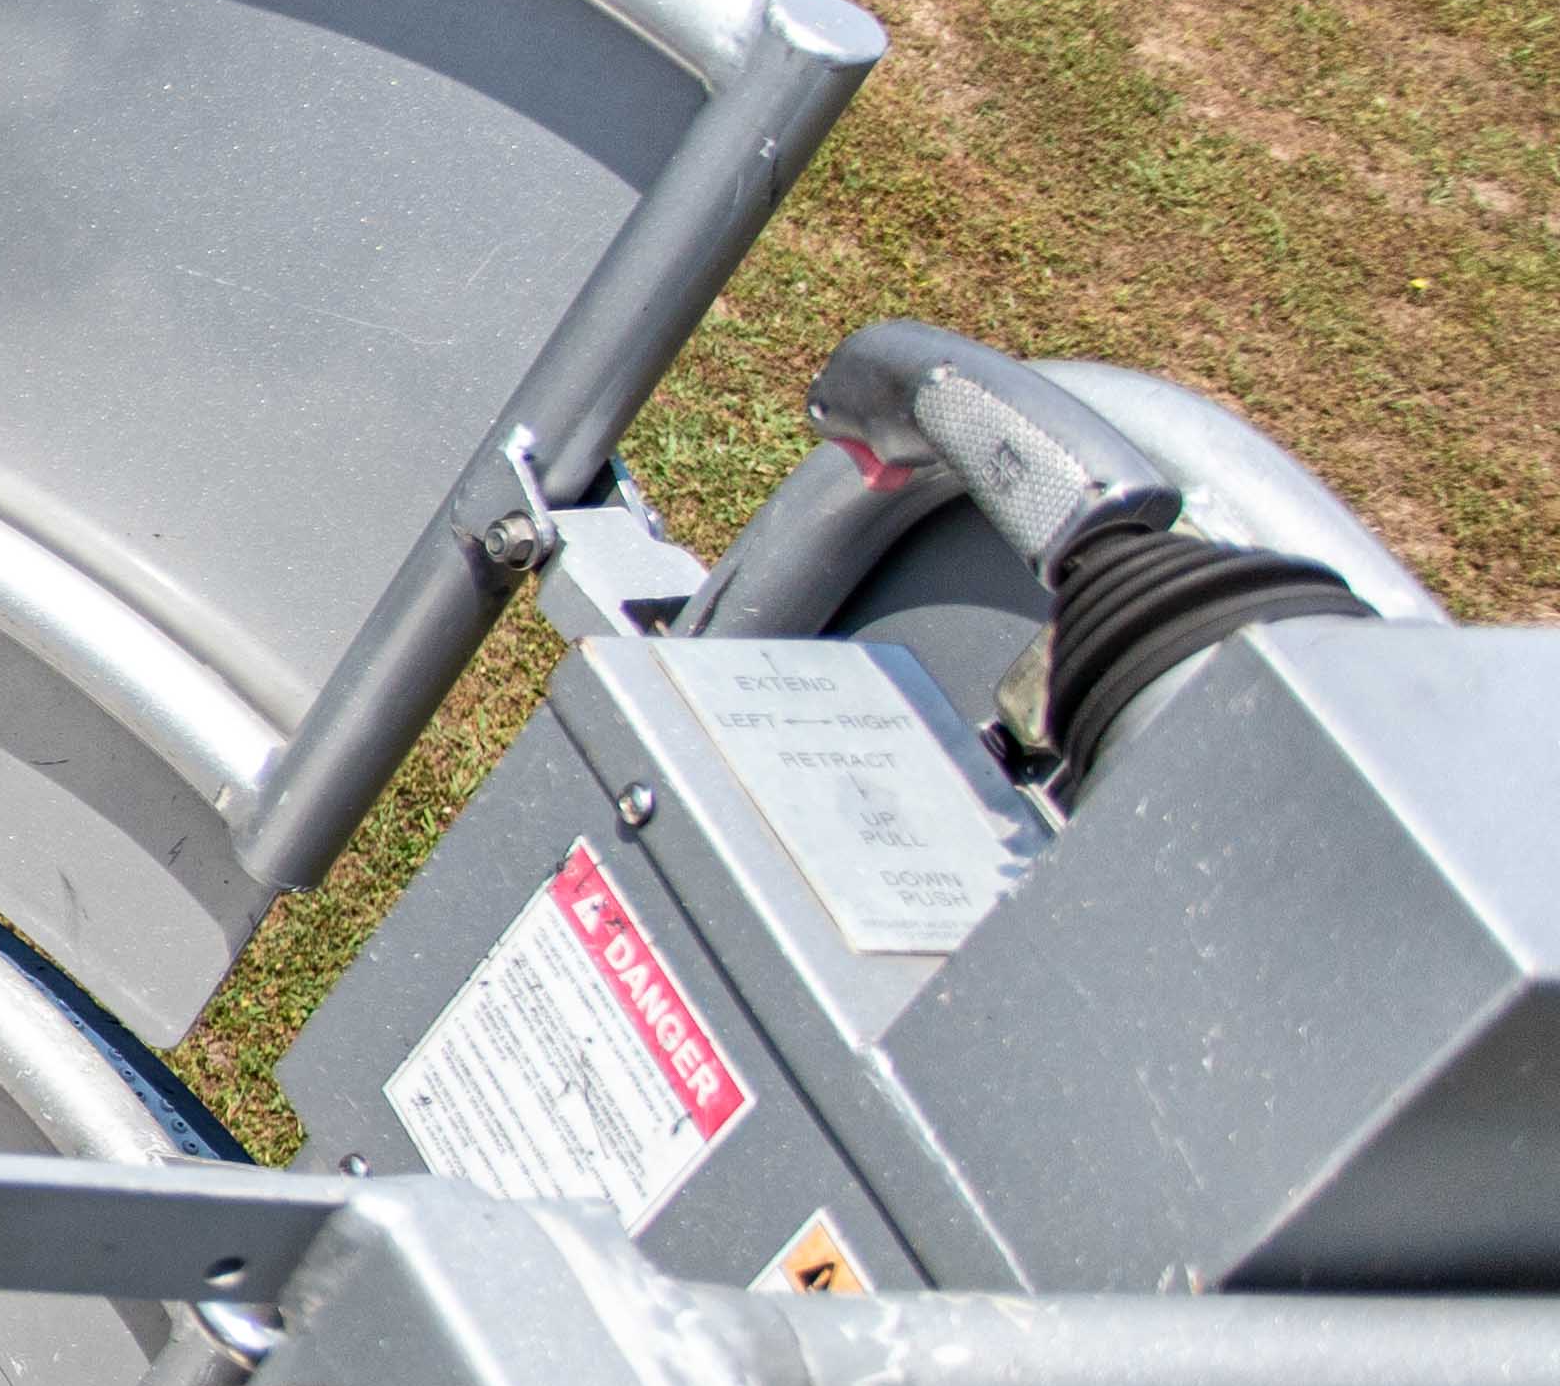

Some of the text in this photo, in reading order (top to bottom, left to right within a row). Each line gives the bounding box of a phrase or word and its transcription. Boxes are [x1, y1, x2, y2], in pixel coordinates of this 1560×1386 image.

[734, 675, 837, 692] EXTEND
[714, 712, 915, 730] LEFT RIGHT
[777, 751, 897, 768] RETRACT
[859, 811, 896, 827] UP
[858, 830, 929, 848] PULL
[879, 869, 964, 888] DOWN
[897, 889, 973, 908] PUSH
[603, 932, 719, 1108] DANGER
